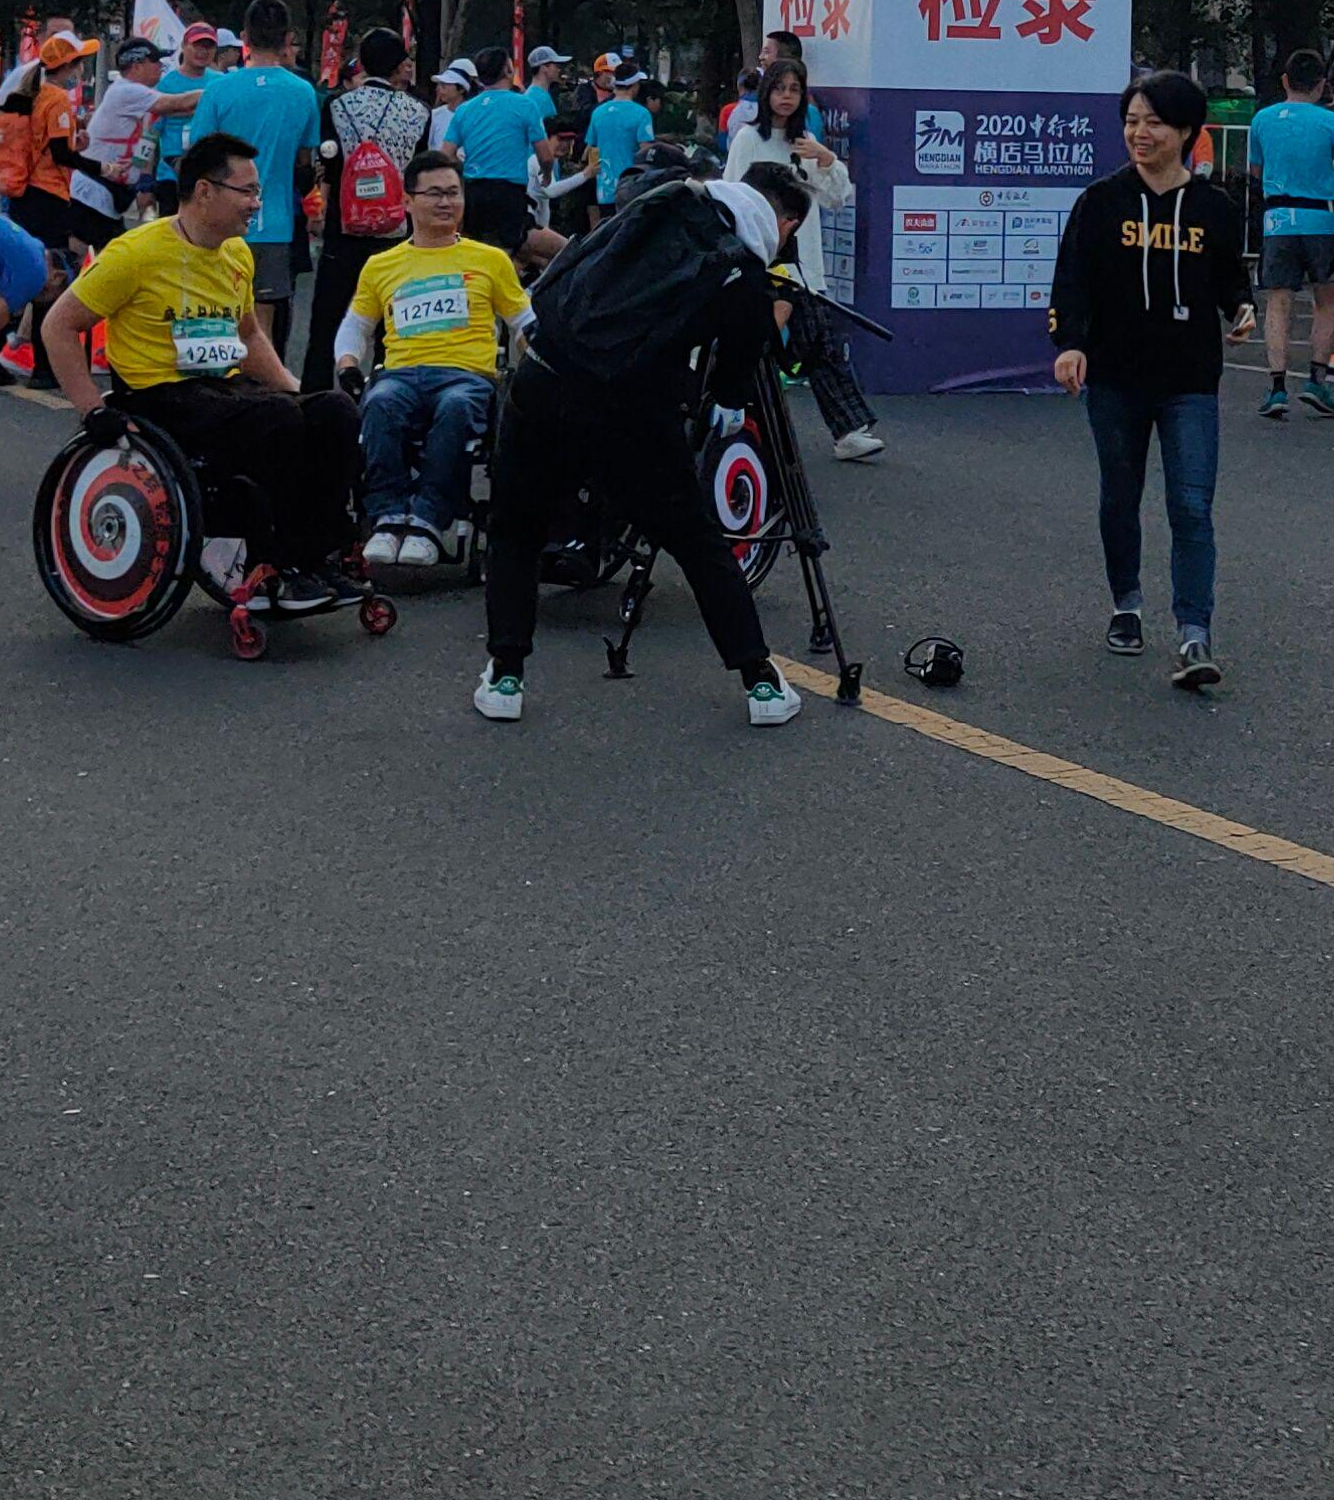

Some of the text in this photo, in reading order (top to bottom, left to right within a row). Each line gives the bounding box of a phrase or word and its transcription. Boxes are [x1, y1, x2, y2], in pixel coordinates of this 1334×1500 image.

[918, 153, 961, 163] HENGDIAN
[974, 141, 1094, 164] 横店马拉松
[975, 165, 1094, 176] HENGDIAN MARATHON
[1120, 220, 1205, 254] SMILE
[401, 298, 457, 322] 12742
[186, 345, 239, 364] 12462
